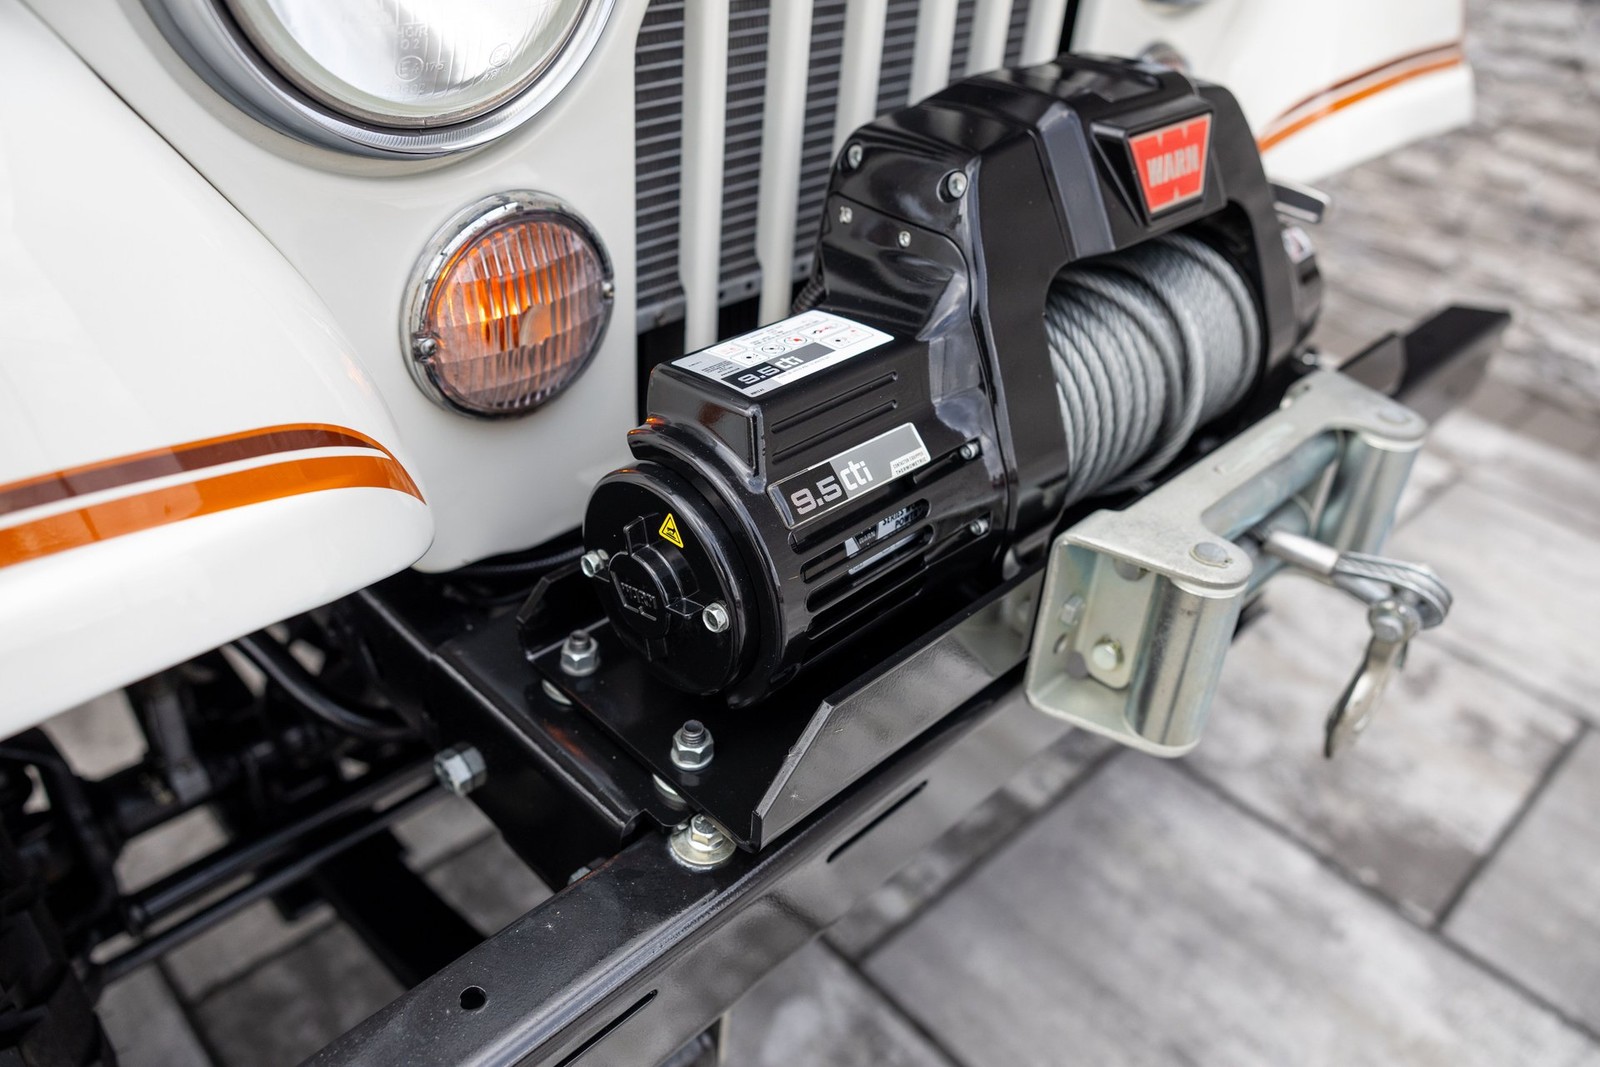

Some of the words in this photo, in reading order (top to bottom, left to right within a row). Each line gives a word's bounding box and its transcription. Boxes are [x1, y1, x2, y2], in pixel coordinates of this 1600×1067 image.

[1146, 143, 1200, 188] WARN
[737, 365, 780, 384] 9.5
[790, 475, 843, 515] 9.5
[839, 460, 873, 491] cti
